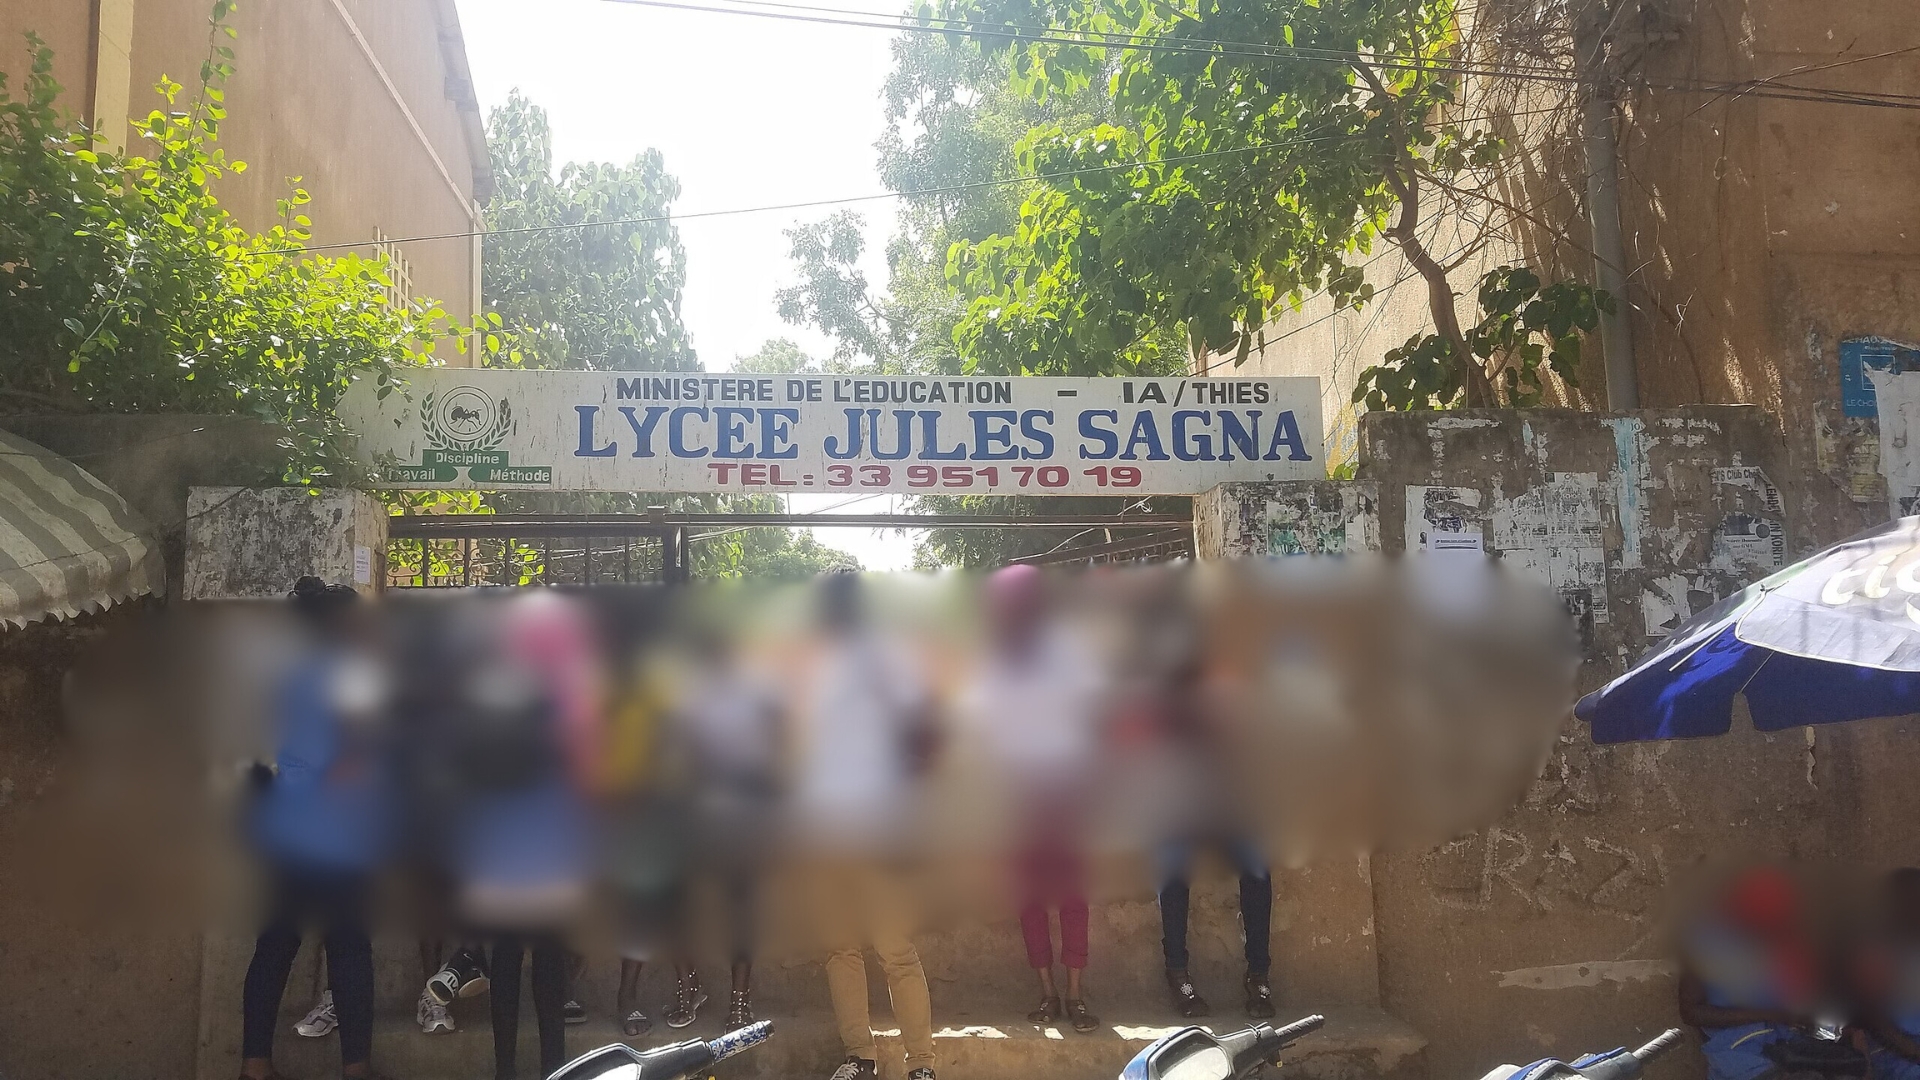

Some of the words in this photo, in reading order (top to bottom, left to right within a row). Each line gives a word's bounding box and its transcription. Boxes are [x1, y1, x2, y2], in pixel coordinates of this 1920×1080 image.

[616, 377, 774, 402] MINISTERE
[788, 379, 823, 402] DE
[833, 378, 1012, 404] L'EDUCATION
[573, 405, 800, 459] LYCEE
[822, 407, 1055, 461] JULES
[1077, 409, 1313, 462] SAGNA
[435, 452, 500, 465] Discipline
[489, 467, 551, 482] Méthode
[706, 462, 813, 487] TEL:
[826, 464, 892, 488] 33
[906, 465, 999, 488] 951
[1010, 465, 1070, 488] 70
[1082, 465, 1142, 488] 19
[1726, 469, 1743, 480] Club
[1770, 534, 1784, 567] KORITE
